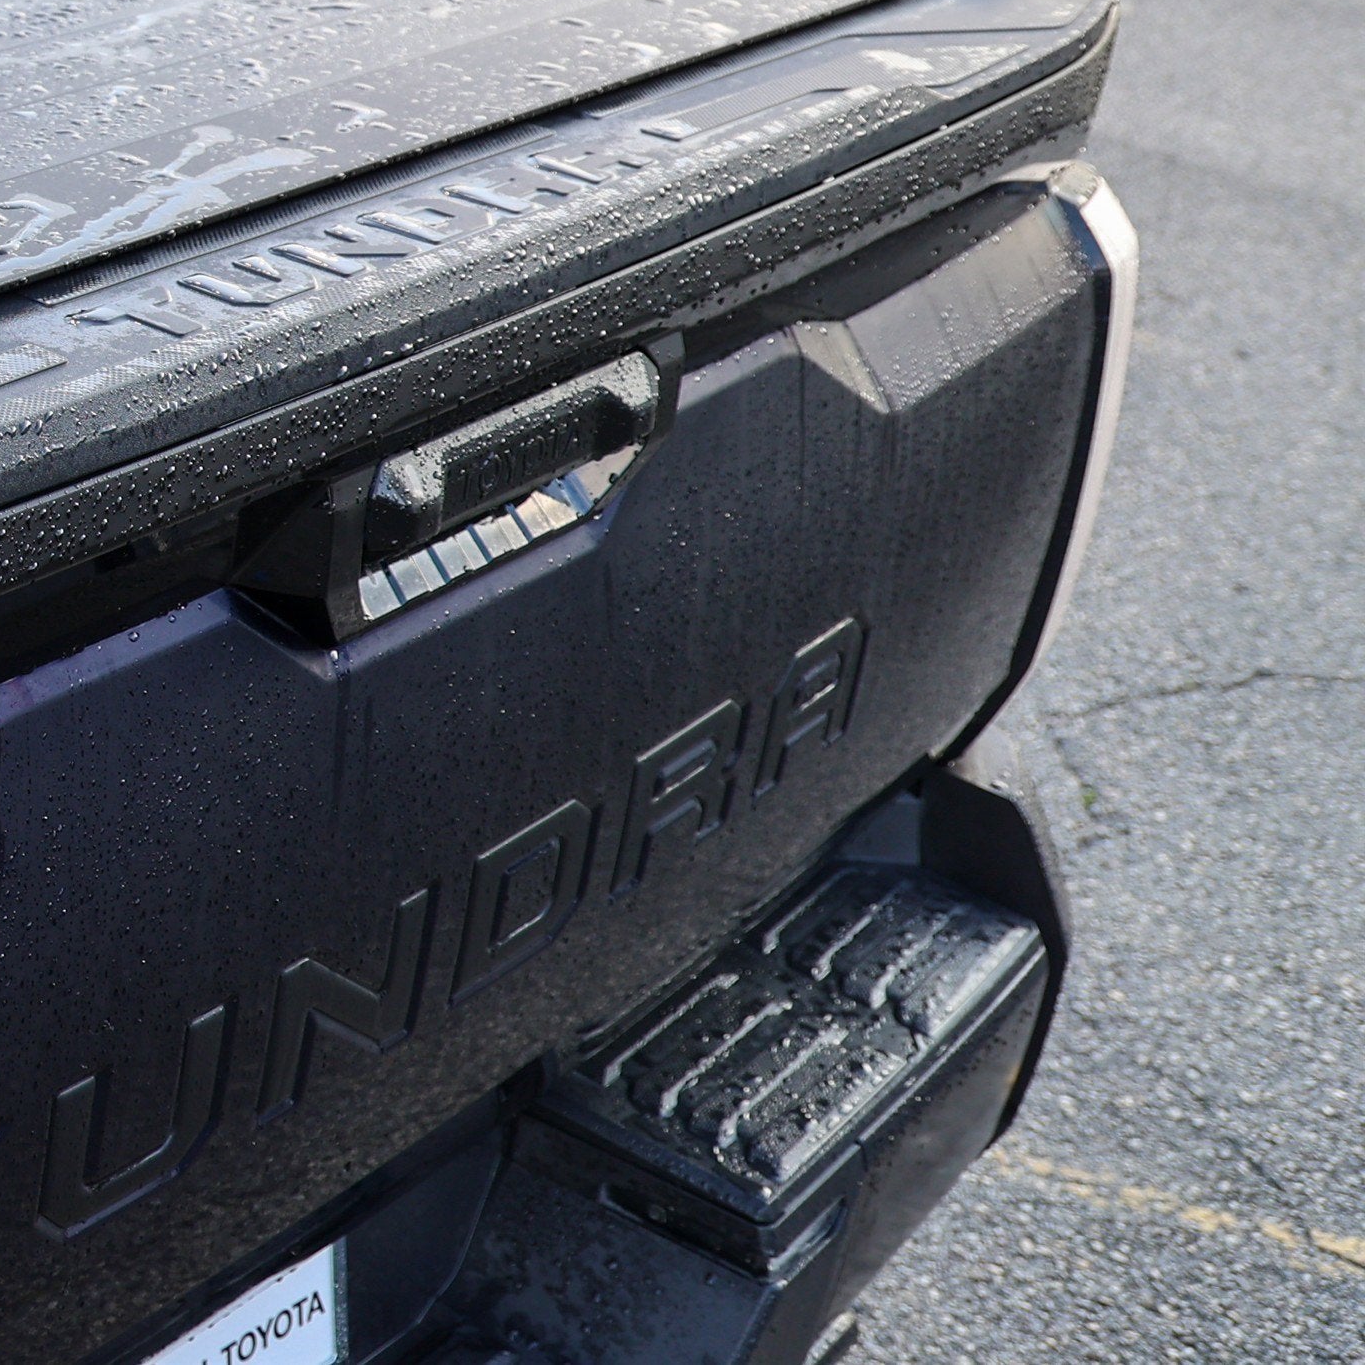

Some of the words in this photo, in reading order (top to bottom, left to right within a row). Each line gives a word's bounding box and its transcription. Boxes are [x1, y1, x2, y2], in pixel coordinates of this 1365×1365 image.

[67, 147, 654, 335] TUNDRA
[458, 427, 582, 502] TOYOTA
[221, 1291, 325, 1365] TOYOTA
